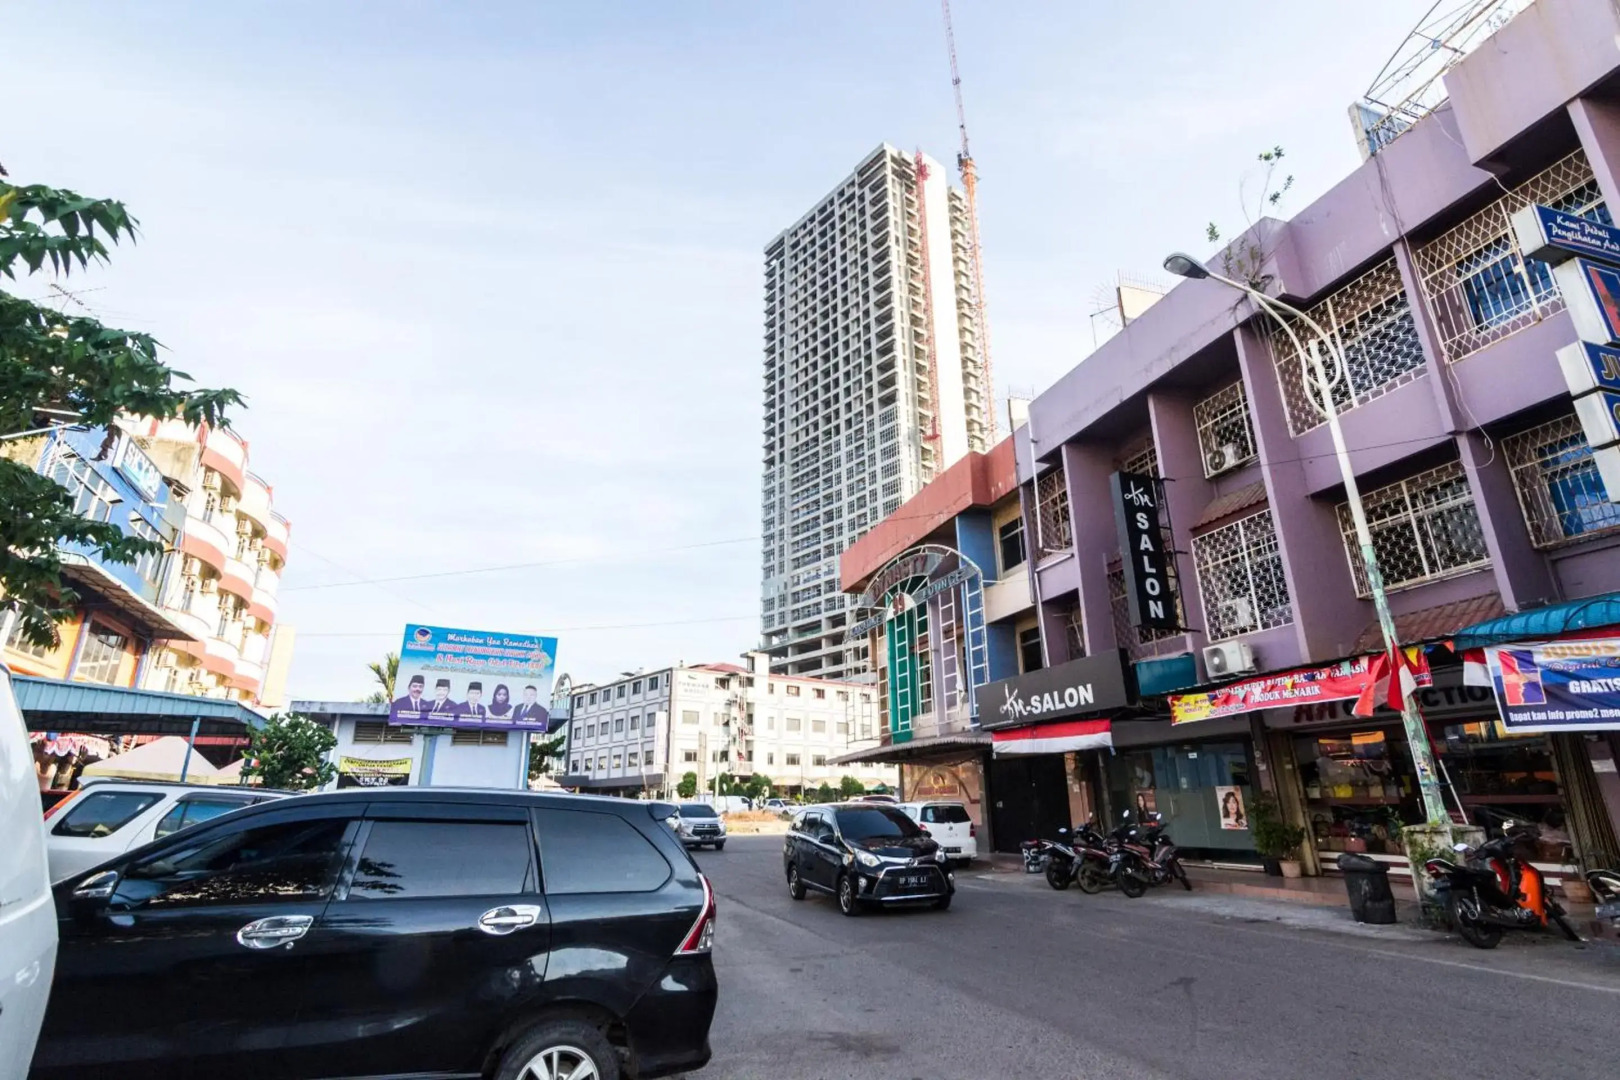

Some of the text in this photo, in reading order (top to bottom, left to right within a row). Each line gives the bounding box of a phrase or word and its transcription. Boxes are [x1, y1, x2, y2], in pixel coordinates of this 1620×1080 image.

[1547, 222, 1602, 247] Penglihatan
[1556, 214, 1610, 239] Kami Peduli
[1135, 512, 1165, 619] SALON
[1282, 684, 1321, 699] MENARIK
[1509, 712, 1531, 722] Dapat
[1531, 711, 1547, 721] kan
[1547, 710, 1564, 720] info
[1565, 708, 1599, 721] promo2
